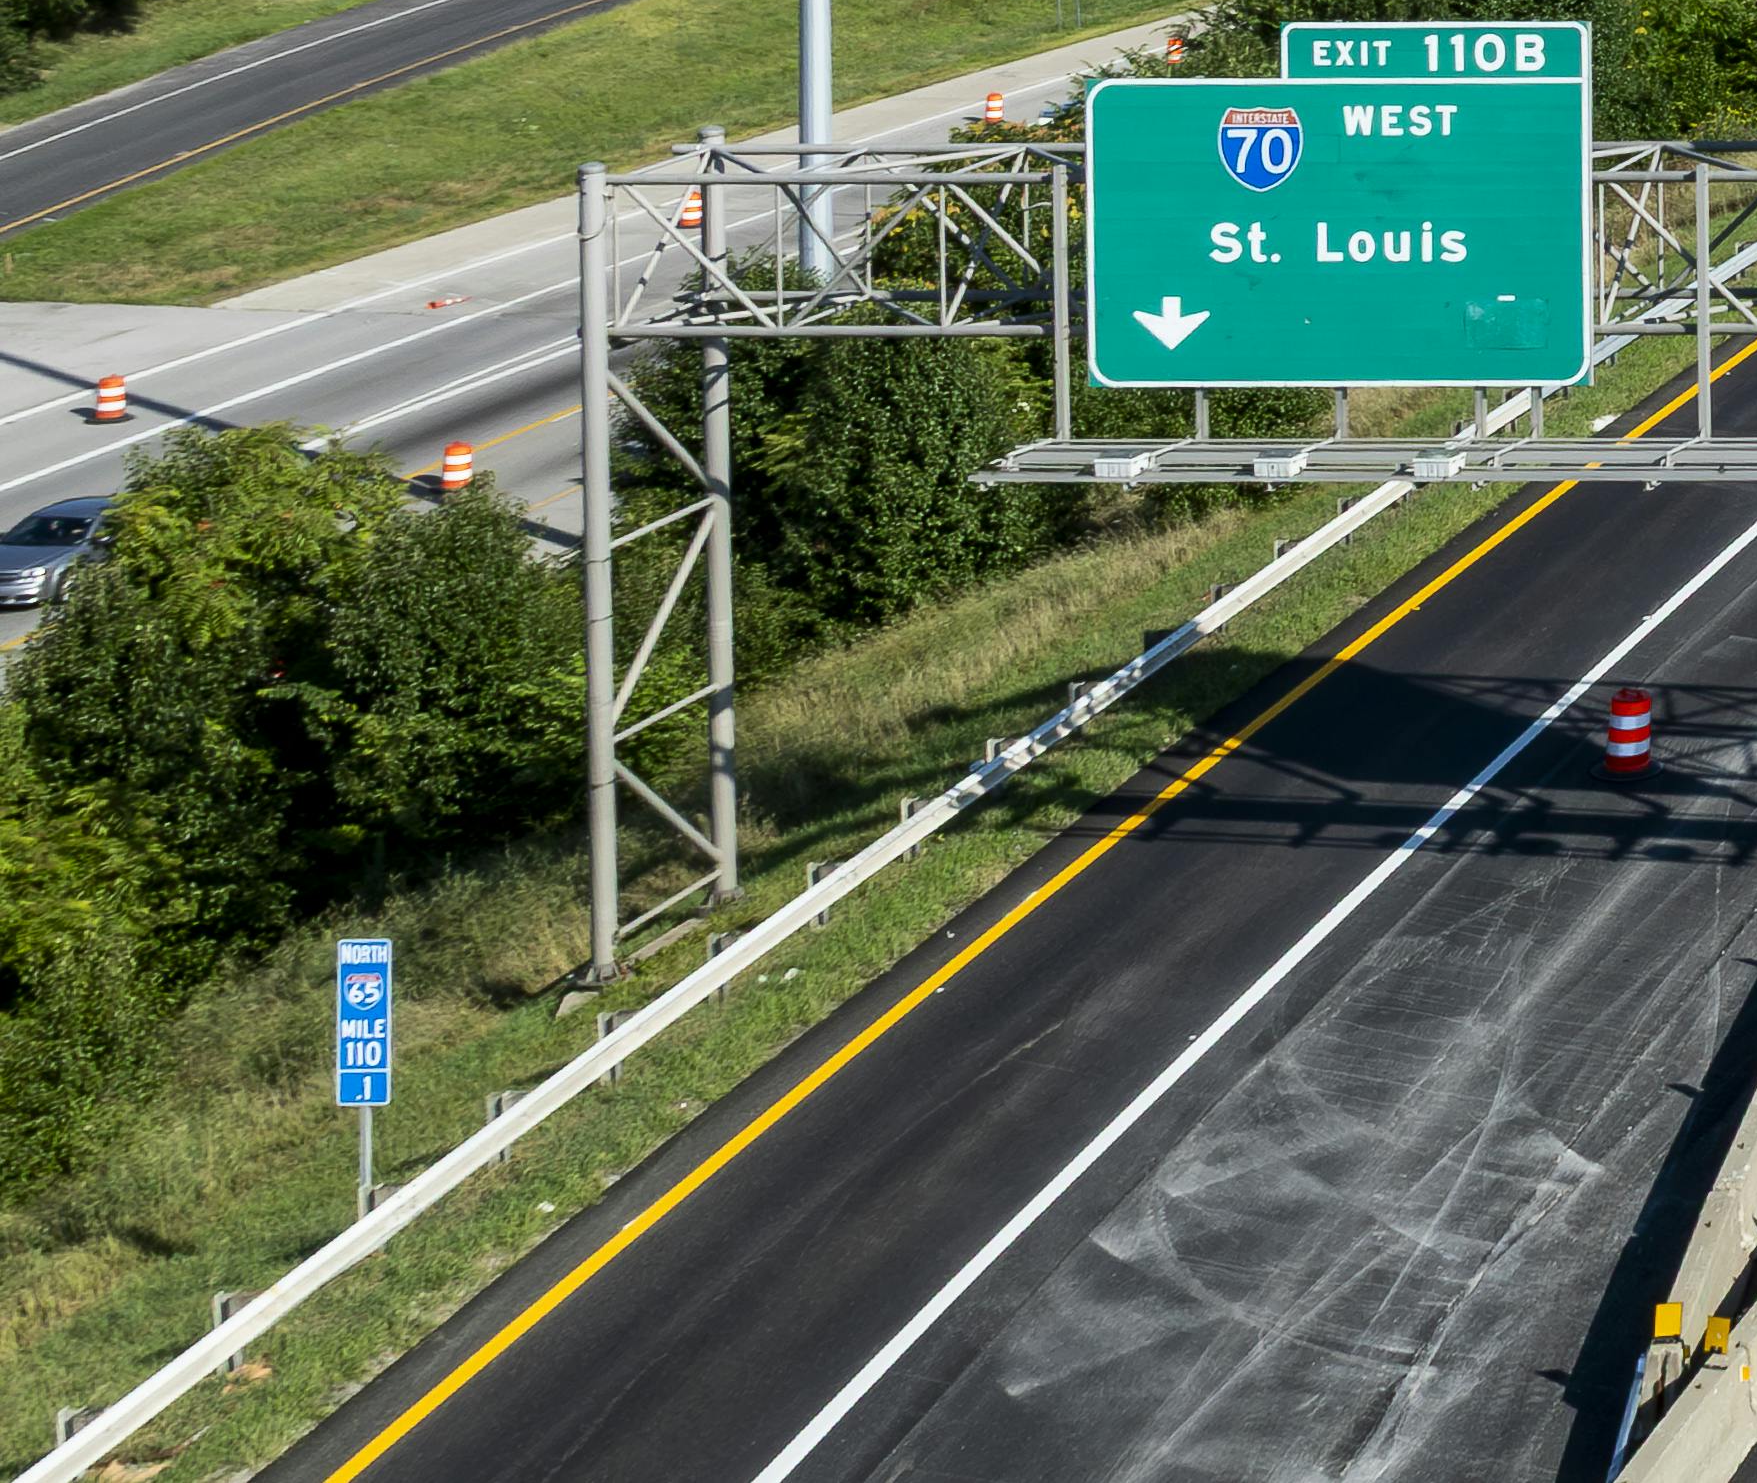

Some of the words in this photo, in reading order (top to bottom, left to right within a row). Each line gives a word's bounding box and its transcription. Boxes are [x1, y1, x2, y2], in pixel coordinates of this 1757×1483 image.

[1312, 39, 1392, 67] EXIT
[1424, 33, 1546, 72] 110B
[1231, 112, 1290, 124] INTERSTATE
[1343, 104, 1458, 137] WEST
[1227, 128, 1293, 174] 70
[1209, 222, 1281, 263] St.
[1316, 221, 1467, 263] Louis
[341, 944, 388, 965] NORTH
[348, 981, 380, 1004] 65
[341, 1018, 386, 1039] MILE
[346, 1041, 382, 1067] 110
